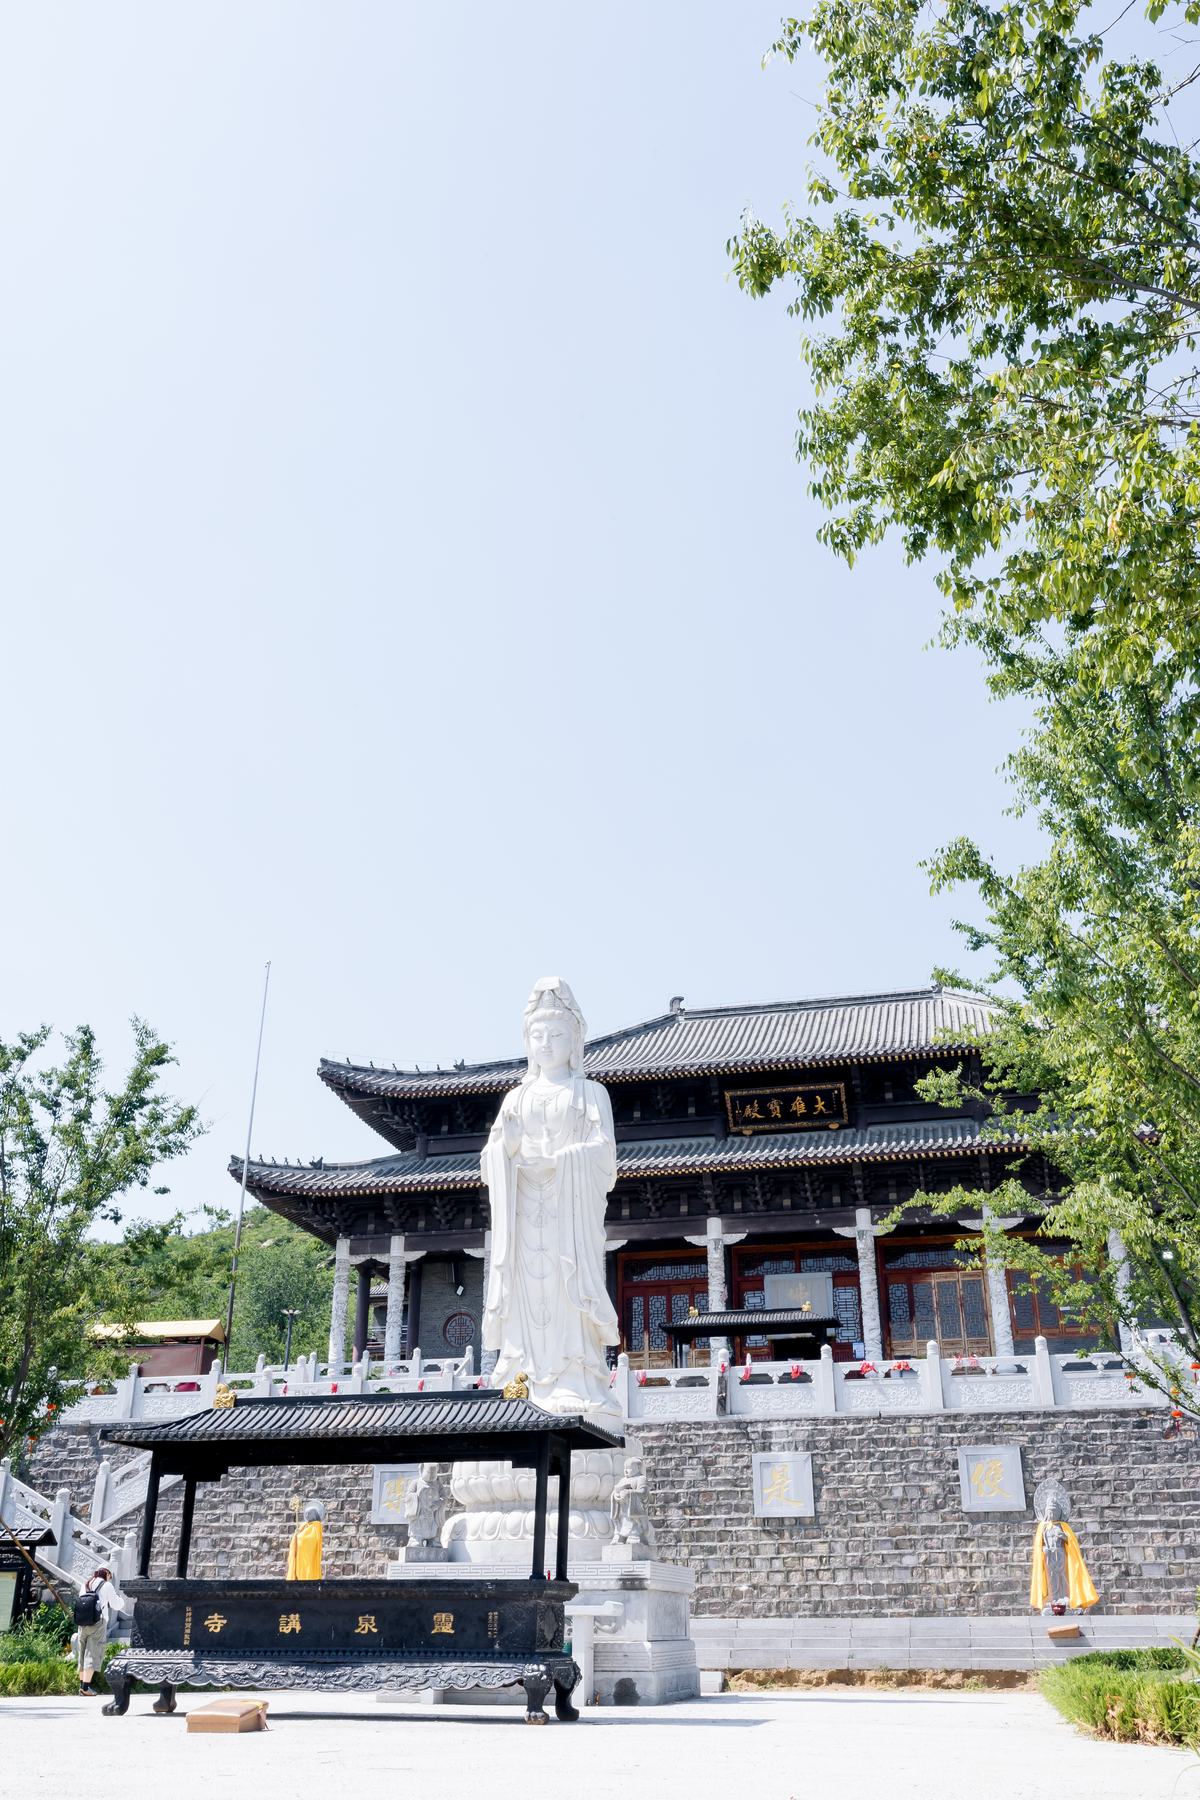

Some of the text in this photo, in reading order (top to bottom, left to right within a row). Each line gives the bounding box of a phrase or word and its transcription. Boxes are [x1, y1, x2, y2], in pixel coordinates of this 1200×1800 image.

[743, 1096, 832, 1118] 大雄寶殿
[763, 1464, 803, 1506] 是
[204, 1613, 454, 1634] 靈泉講寺
